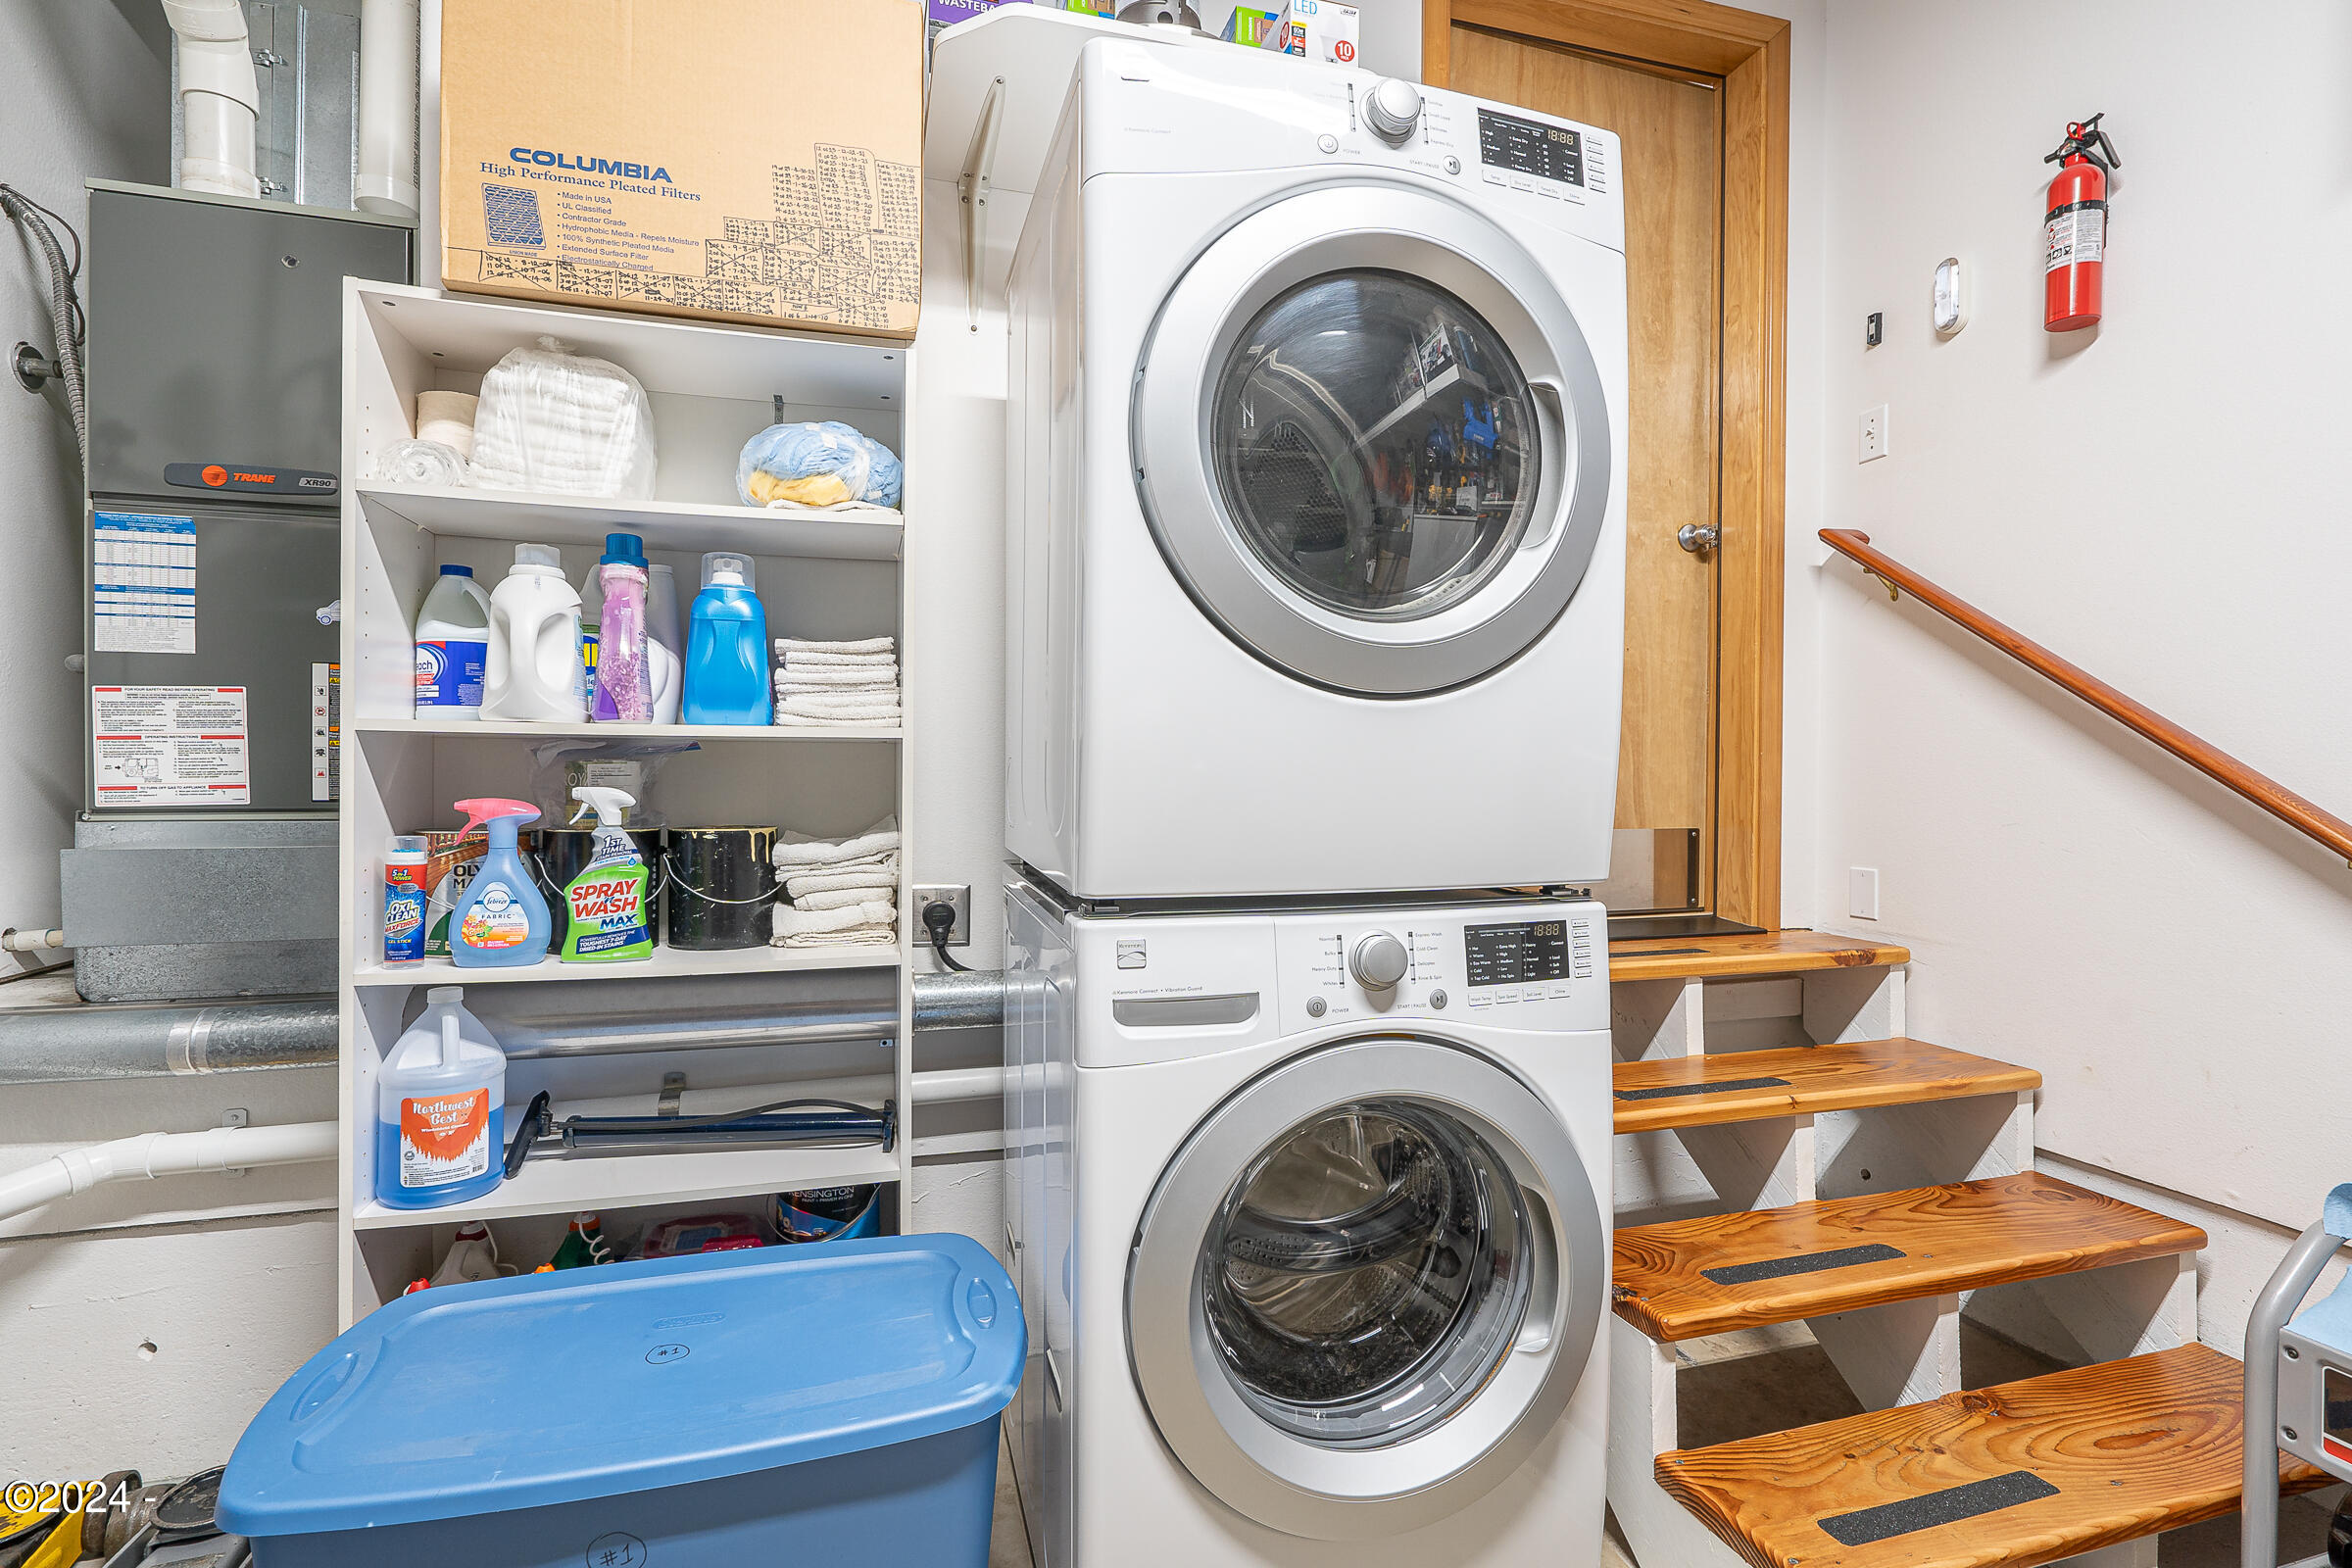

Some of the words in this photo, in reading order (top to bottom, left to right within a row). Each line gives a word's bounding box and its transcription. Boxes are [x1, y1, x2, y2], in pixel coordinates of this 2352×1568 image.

[1338, 43, 1353, 57] 10
[1548, 129, 1574, 146] 18:88
[510, 147, 673, 183] COLUMBIA
[479, 162, 515, 178] High
[521, 168, 606, 189] Performance
[611, 178, 656, 195] Pleated
[662, 186, 701, 202] Filters
[562, 191, 584, 203] Made
[594, 195, 612, 205] USA
[562, 202, 573, 211] UL
[575, 203, 612, 215] Classified
[562, 212, 602, 224] Contractor
[603, 217, 627, 227] Grade
[562, 223, 610, 237] Hydrophobic
[612, 226, 634, 238] Media
[641, 231, 666, 244] Repels
[667, 235, 700, 247] Moisture
[563, 233, 584, 244] 100%
[585, 236, 620, 250] Synthetic
[622, 240, 651, 252] Pleated
[652, 243, 674, 255] Media
[562, 244, 598, 256] Extended
[600, 247, 628, 259] Surface
[629, 250, 649, 262] Filter
[562, 254, 620, 269] Electrostatically
[621, 260, 654, 273] Charged
[233, 472, 276, 484] TRANE
[304, 478, 332, 487] XR90
[604, 835, 623, 848] 1ST
[601, 844, 627, 856] TIME
[571, 879, 638, 902] SPRAY
[391, 901, 412, 914] OXI
[486, 897, 508, 905] febreze
[575, 896, 638, 918] WASH
[599, 913, 639, 930] MAX
[1534, 924, 1560, 937] 18:88
[412, 1096, 475, 1114] Northwest
[430, 1112, 459, 1126] Best
[658, 1347, 680, 1356] #1
[599, 1543, 634, 1567] #1
